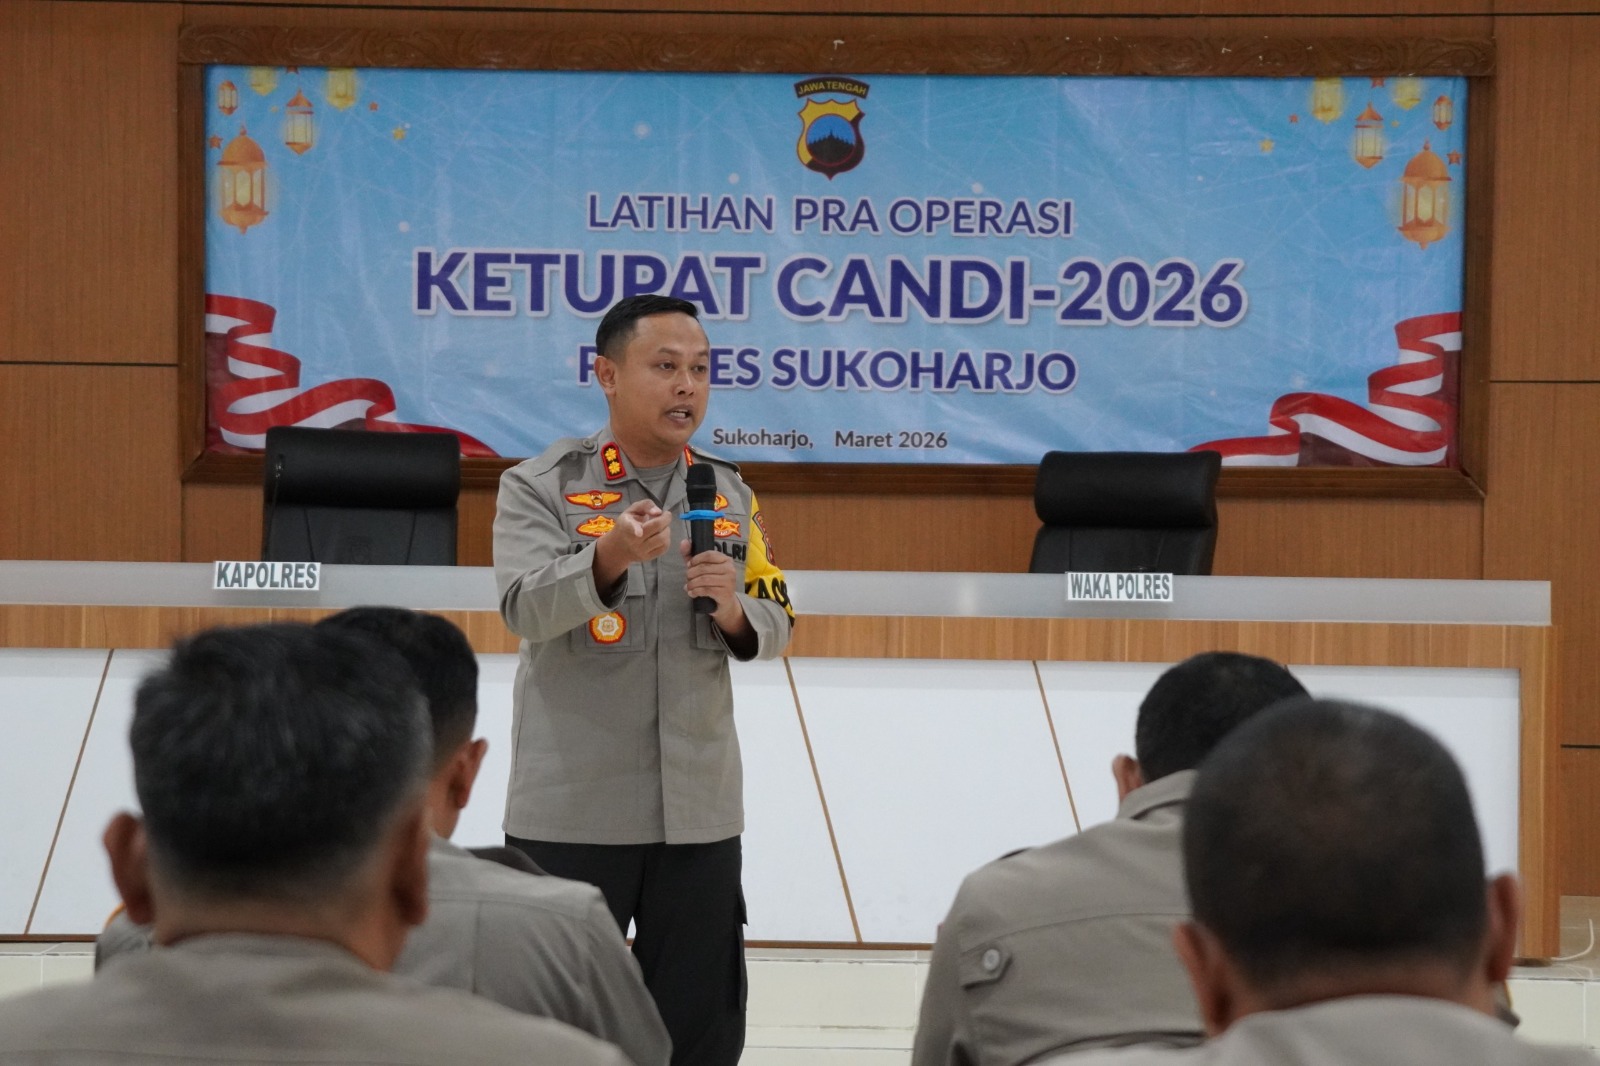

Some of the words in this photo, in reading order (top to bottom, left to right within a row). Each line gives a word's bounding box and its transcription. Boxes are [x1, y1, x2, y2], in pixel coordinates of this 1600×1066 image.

[798, 82, 825, 95] JAWA
[826, 81, 867, 95] TENGAH
[588, 194, 774, 230] LATIHAN
[795, 198, 879, 232] PRA
[889, 199, 1072, 234] OPERASI
[416, 251, 761, 316] KETUPAT
[777, 257, 1243, 322] CANDI-2026
[771, 348, 1078, 390] SUKOHARJO
[713, 428, 814, 449] Sukoharjo,
[835, 430, 893, 448] Maret
[898, 432, 948, 448] 2026
[216, 562, 317, 588] KAPOLRES
[1070, 573, 1113, 599] WAKA
[1116, 574, 1171, 600] POLRES
